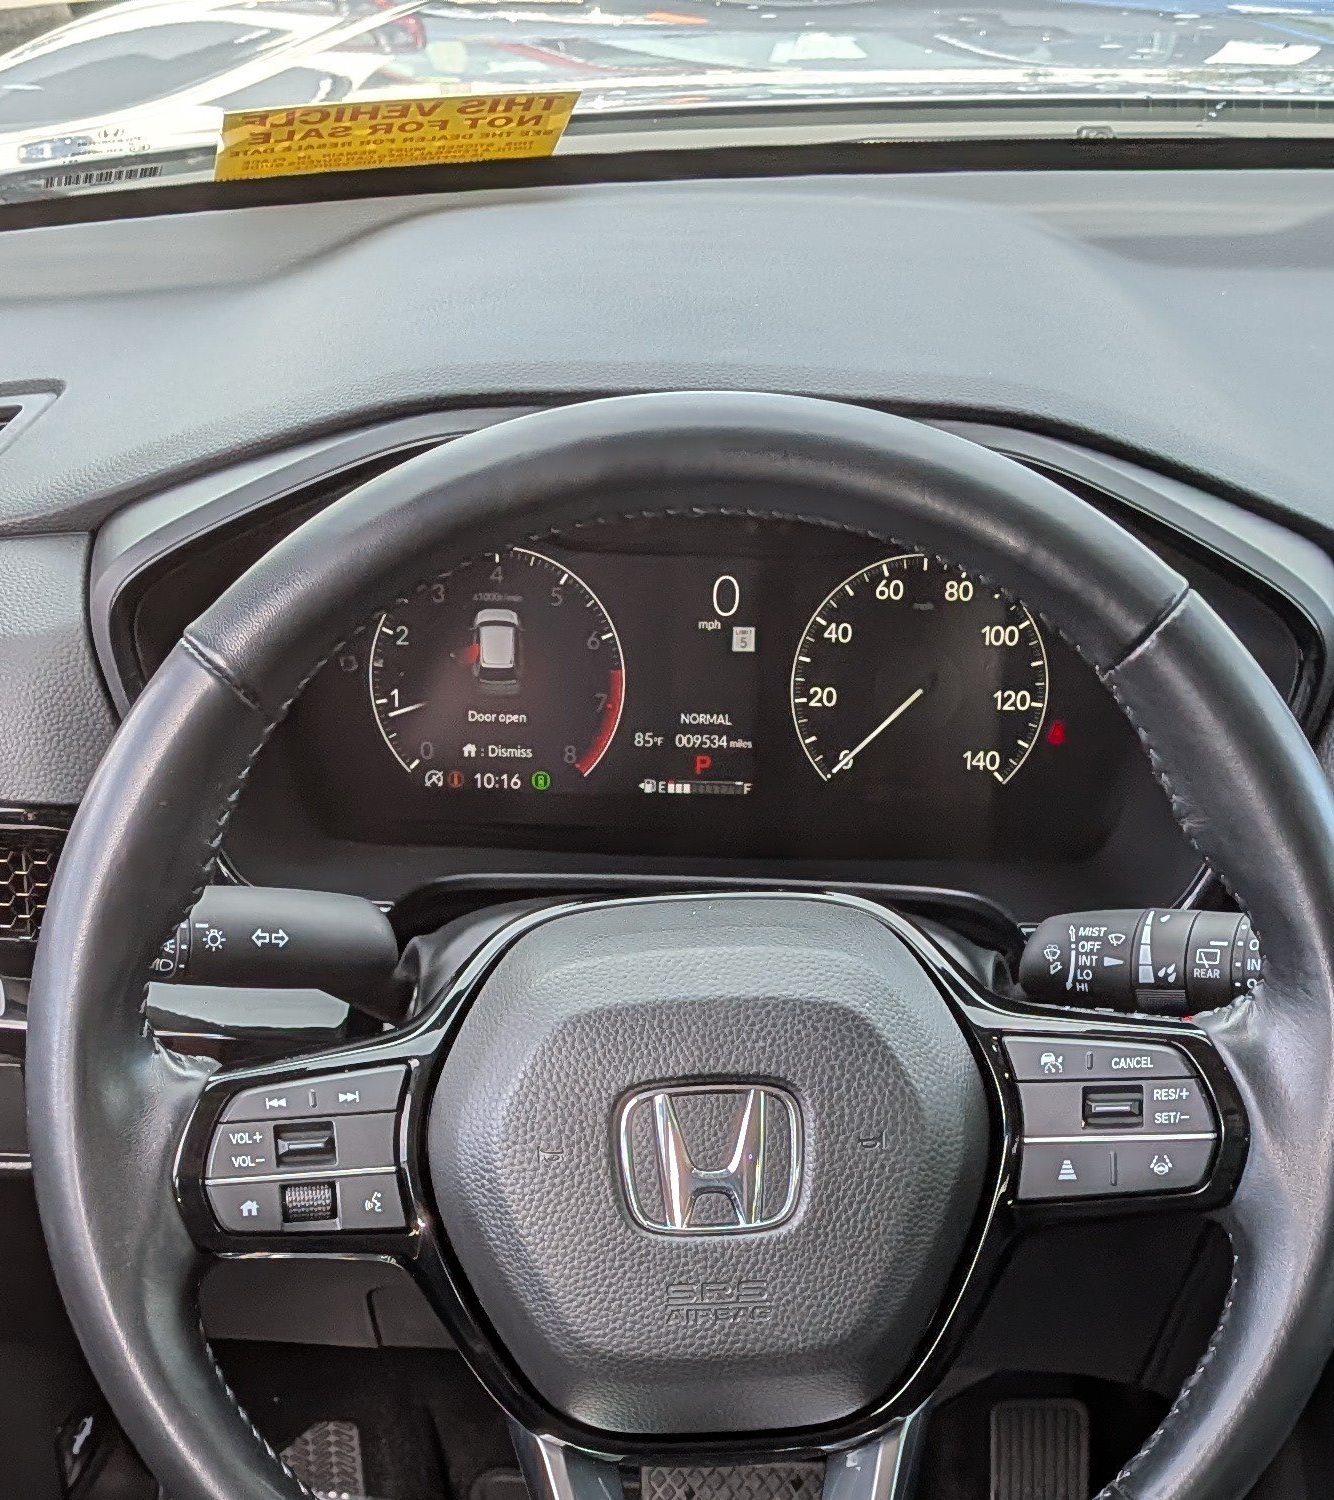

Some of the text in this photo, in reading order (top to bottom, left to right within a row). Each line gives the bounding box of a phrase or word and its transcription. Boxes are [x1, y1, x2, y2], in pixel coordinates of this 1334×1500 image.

[490, 566, 504, 583] 4
[551, 587, 563, 606] 5
[713, 575, 739, 616] 0
[875, 580, 904, 600] 60
[944, 580, 973, 601] 80
[698, 620, 722, 631] mph
[823, 622, 853, 644] 40
[395, 625, 409, 645] 2
[739, 636, 748, 649] 5
[981, 625, 1019, 646] 100
[389, 688, 400, 707] 1
[808, 687, 838, 707] 20
[993, 690, 1031, 711] 120
[467, 711, 527, 725] Door open
[680, 713, 733, 725] NORMAL
[675, 733, 753, 749] 009534 miles
[488, 745, 533, 758] Dismiss
[694, 754, 713, 775] P
[962, 751, 1001, 770] 140
[473, 773, 523, 789] 10:16
[658, 780, 666, 794] E
[744, 782, 753, 794] F
[1078, 926, 1108, 938] MIST
[1078, 941, 1102, 953] OFF
[1078, 955, 1098, 967] INT
[1077, 969, 1093, 981] LO
[1193, 968, 1220, 979] REAR
[1076, 981, 1088, 992] HI
[1111, 1056, 1154, 1069] CANCEL
[1153, 1087, 1190, 1100] RES/+
[666, 1280, 768, 1303] SRS
